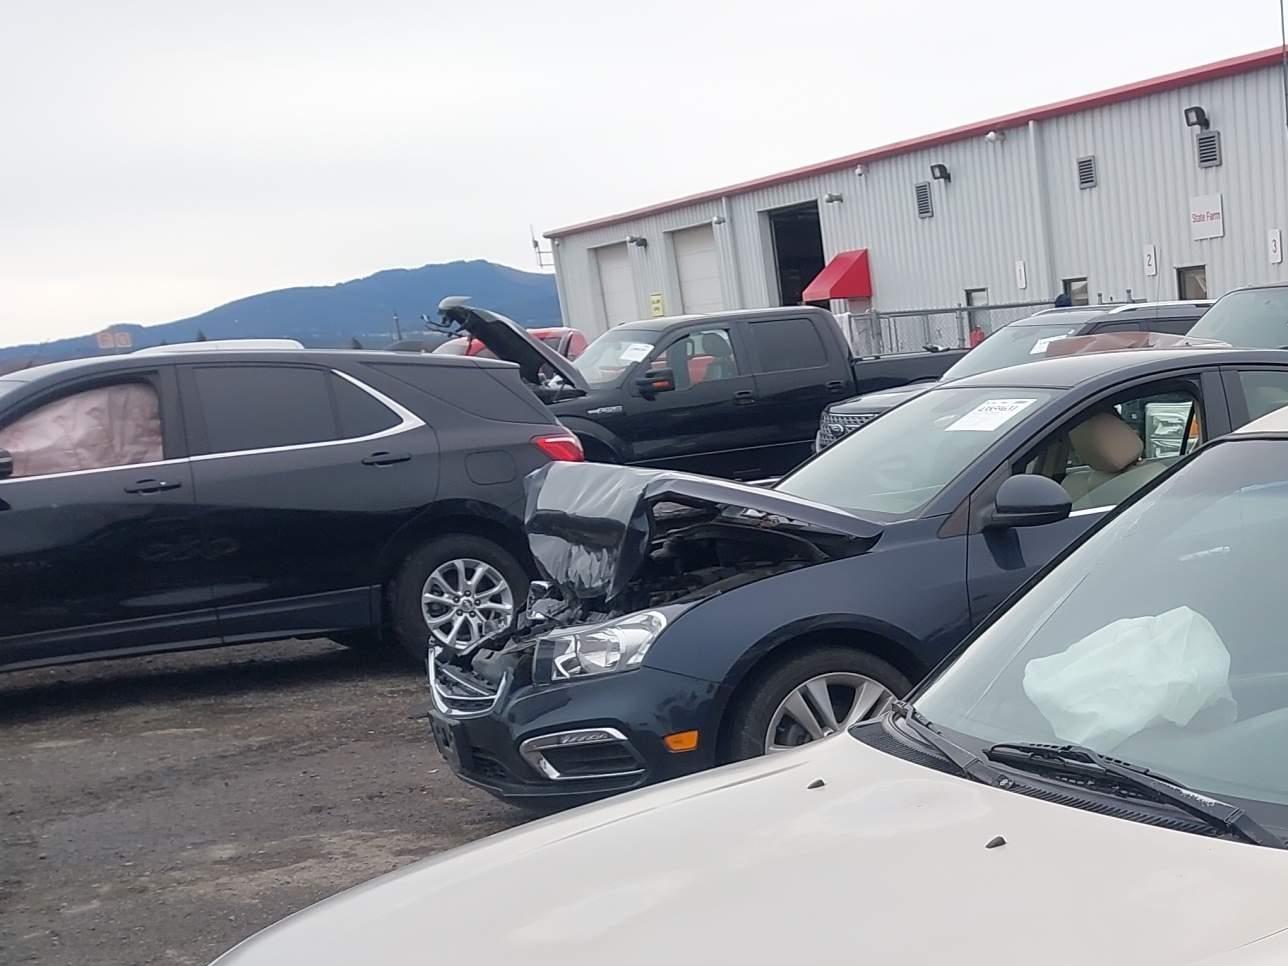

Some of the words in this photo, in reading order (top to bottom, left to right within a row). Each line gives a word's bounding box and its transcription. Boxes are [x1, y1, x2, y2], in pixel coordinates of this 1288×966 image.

[1191, 212, 1206, 223] State
[1206, 211, 1221, 222] Farm
[1272, 239, 1278, 253] 3
[1146, 253, 1153, 267] 2
